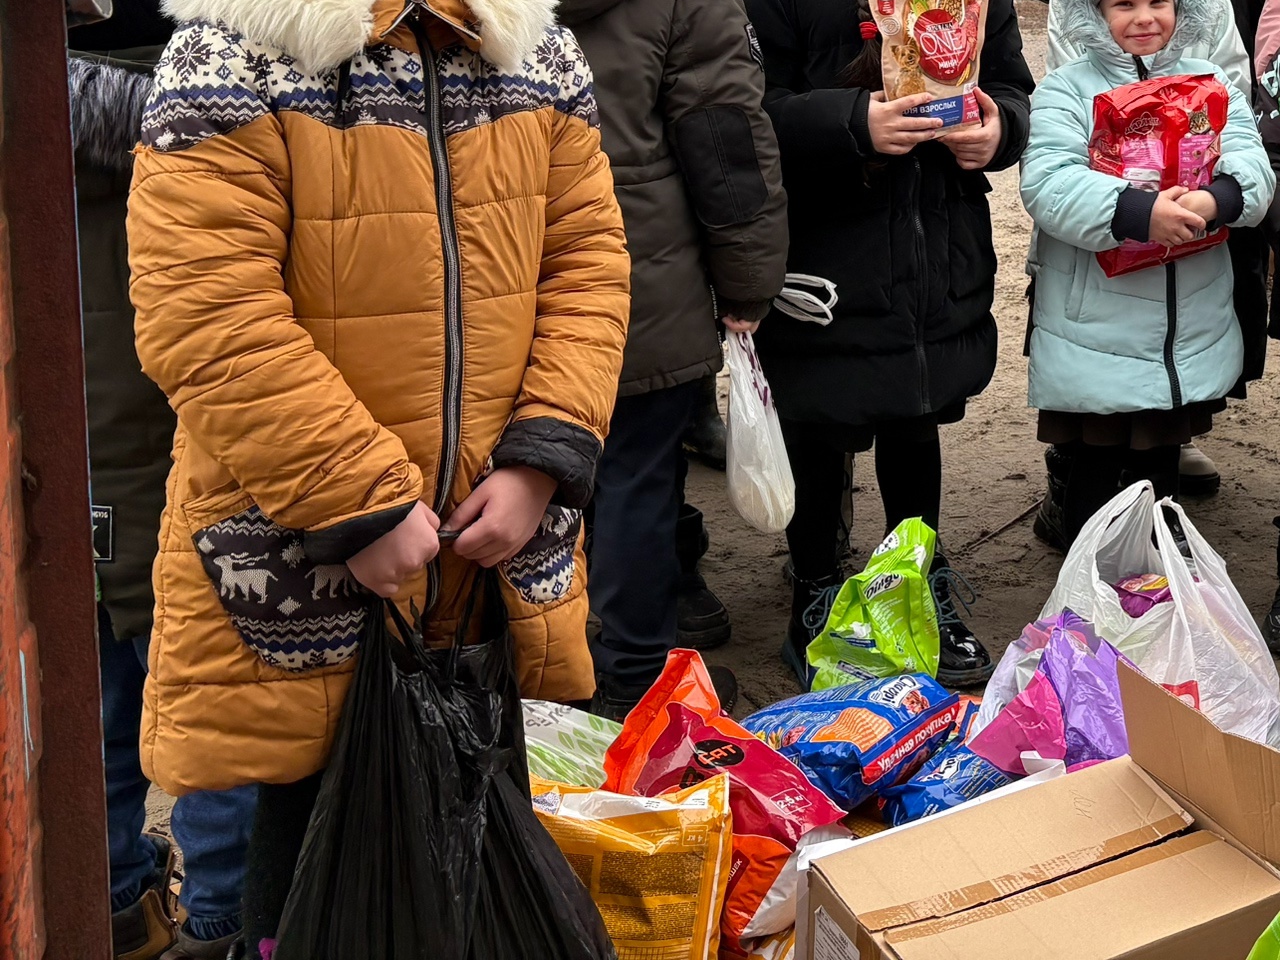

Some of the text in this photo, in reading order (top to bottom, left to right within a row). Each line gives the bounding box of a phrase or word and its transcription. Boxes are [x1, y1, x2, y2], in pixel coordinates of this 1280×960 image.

[920, 30, 962, 55] ONE
[920, 100, 957, 114] ВЗРОСЛЫХ
[877, 738, 914, 772] Удачная
[914, 708, 956, 743] покупка!
